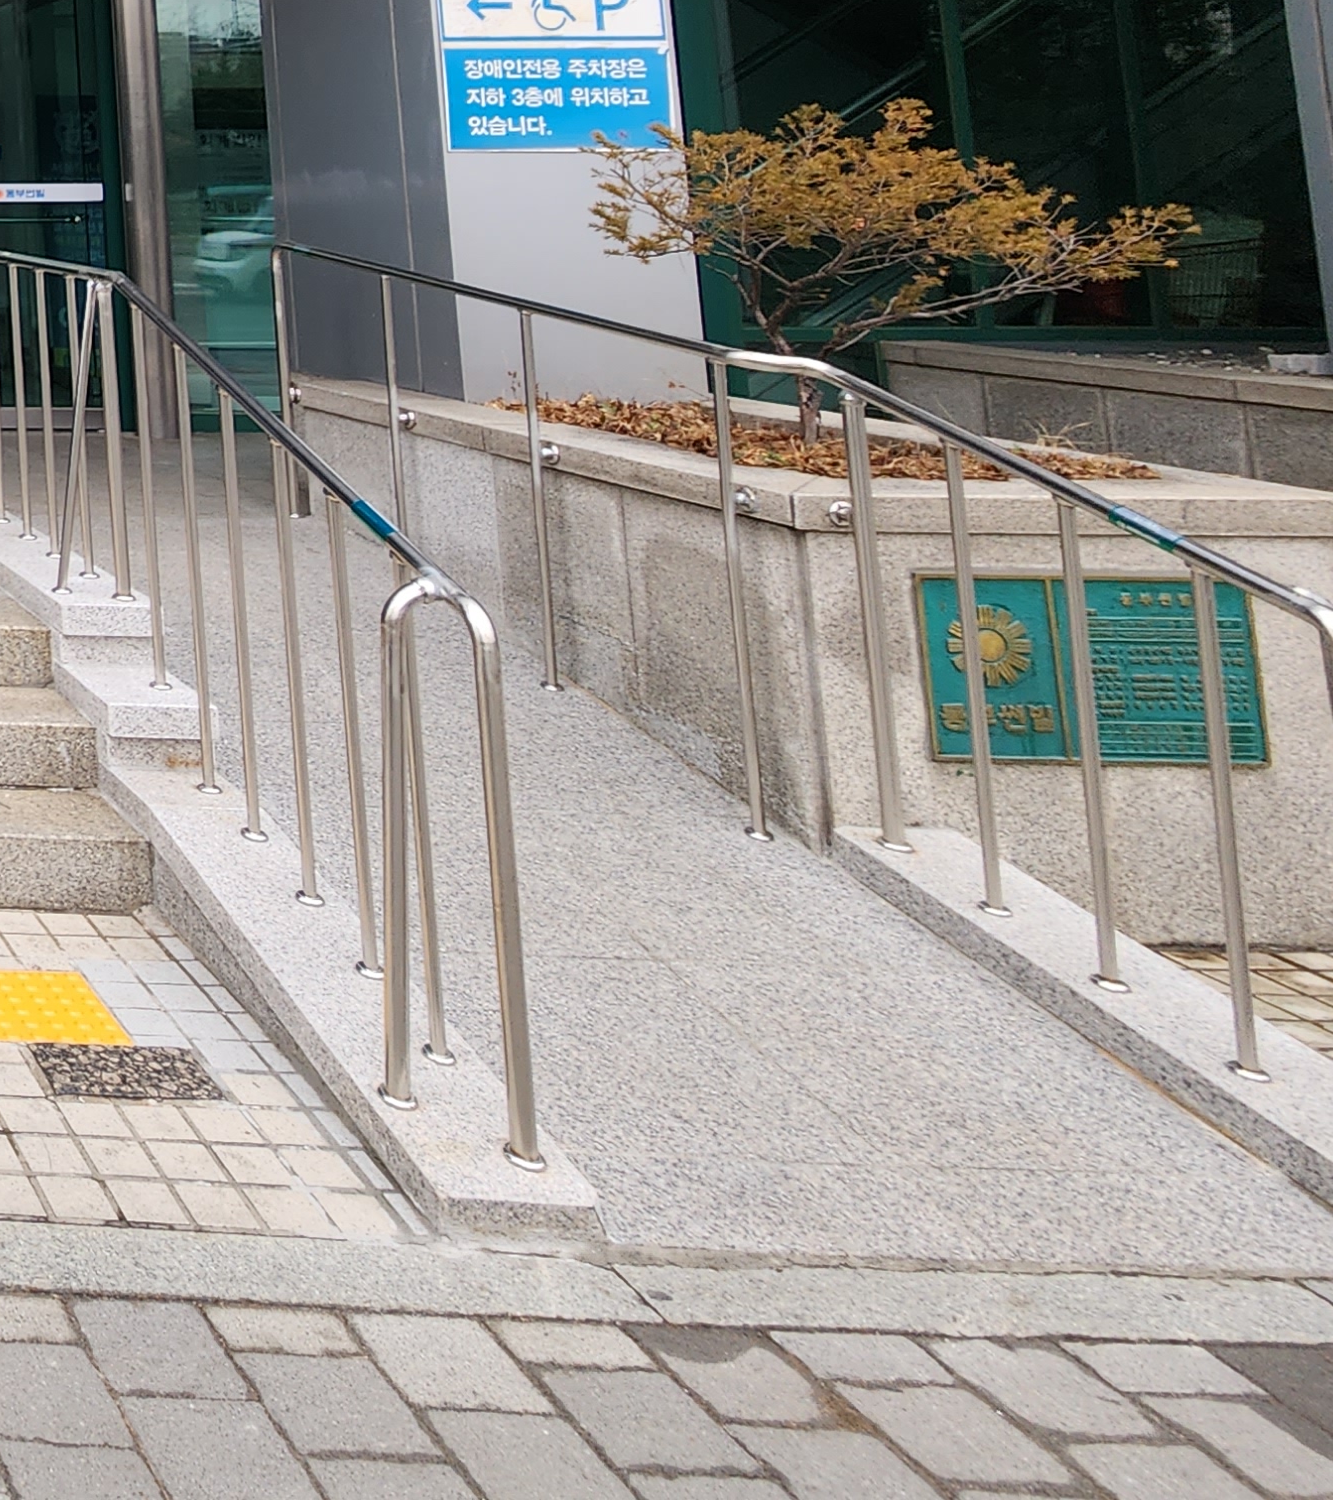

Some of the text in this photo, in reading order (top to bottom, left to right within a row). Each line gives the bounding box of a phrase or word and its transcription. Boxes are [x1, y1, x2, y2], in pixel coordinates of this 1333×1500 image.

[464, 58, 648, 80] 장애인전용 주차장은
[466, 87, 651, 108] 지하 3층에 위치하고
[468, 115, 554, 137] 있습니다.
